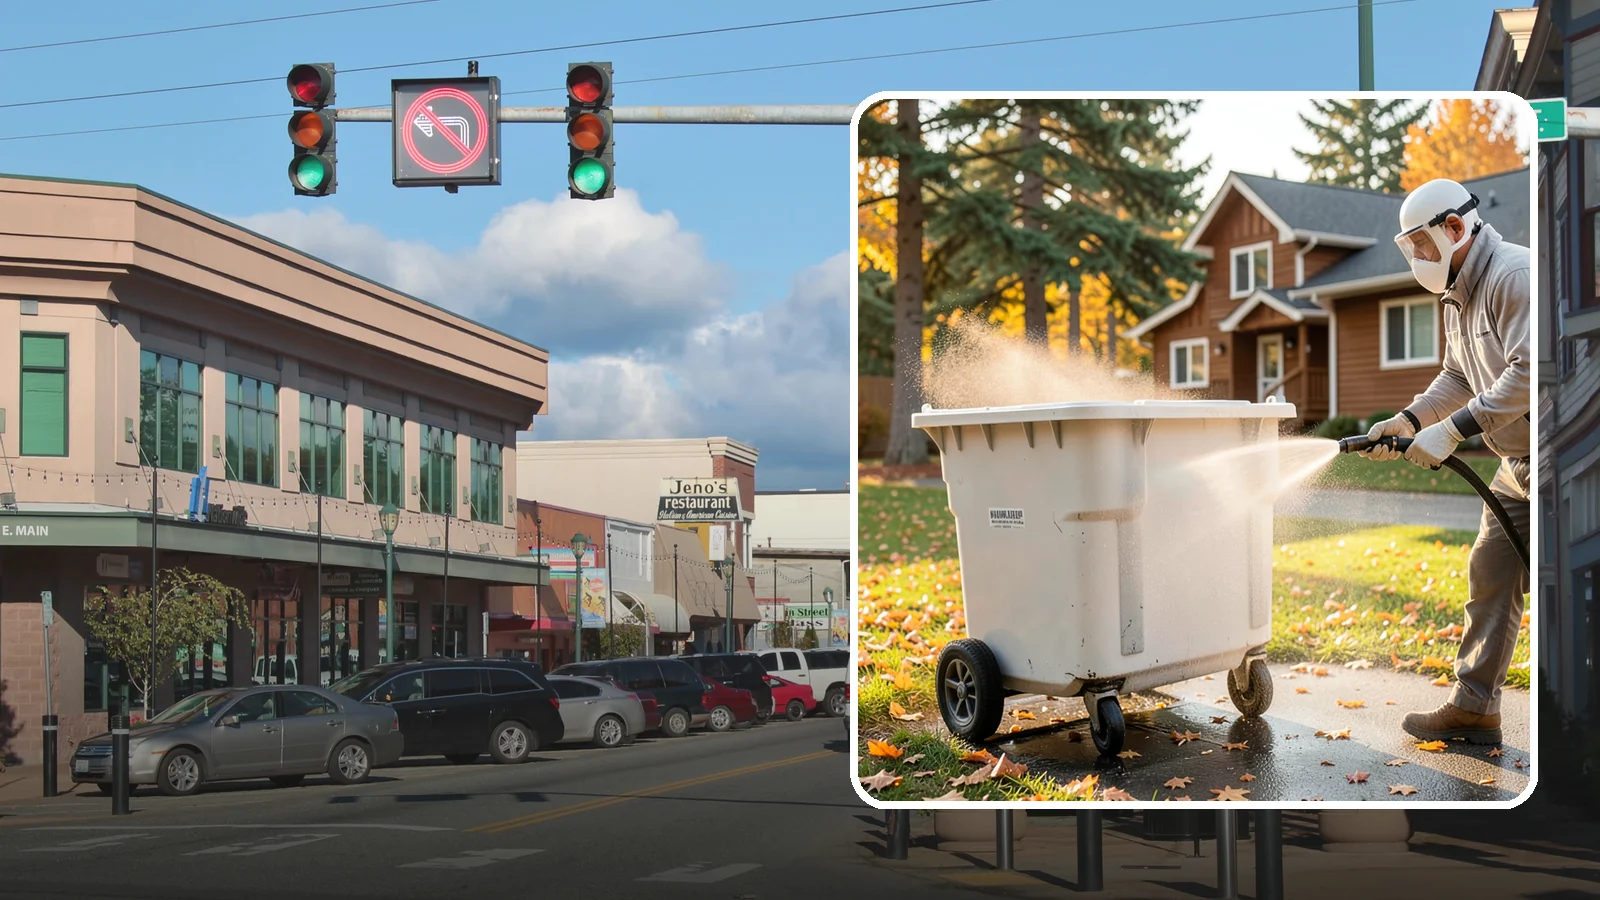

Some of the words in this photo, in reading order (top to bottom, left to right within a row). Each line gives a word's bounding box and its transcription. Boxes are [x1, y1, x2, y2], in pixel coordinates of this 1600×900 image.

[669, 480, 727, 495] Jeno's
[665, 496, 731, 509] restaurant
[658, 509, 681, 520] Italian
[686, 509, 714, 519] American
[715, 509, 738, 519] Cuisine
[2, 525, 13, 536] E.
[15, 525, 49, 536] MAIN
[785, 608, 795, 617] in
[797, 608, 828, 617] Street
